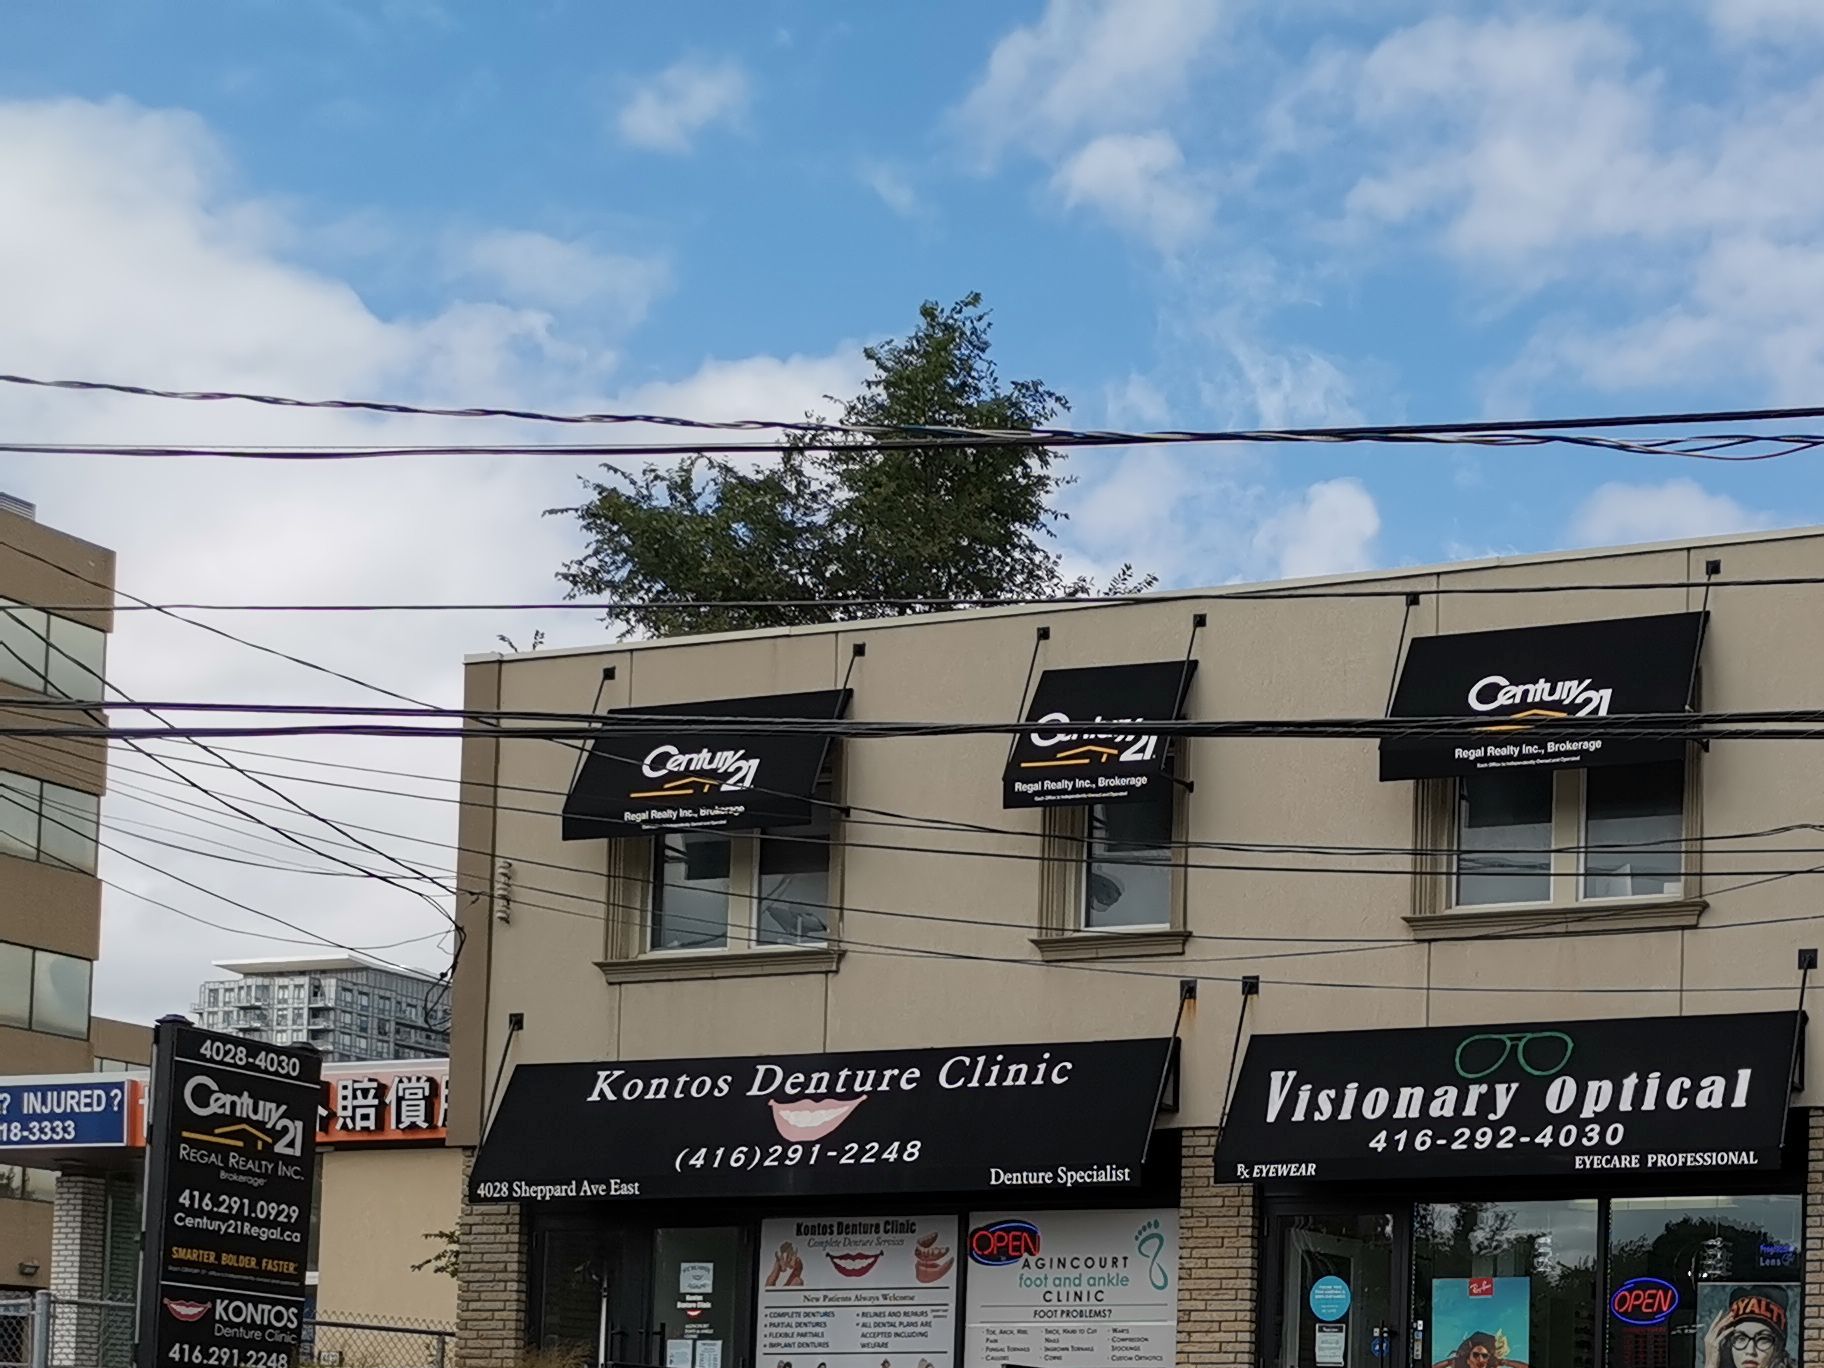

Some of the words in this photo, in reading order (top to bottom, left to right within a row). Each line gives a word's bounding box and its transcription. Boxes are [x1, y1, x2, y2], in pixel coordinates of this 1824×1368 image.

[1467, 675, 1592, 712] Century
[1574, 688, 1612, 718] 21
[1455, 746, 1484, 760] Regal
[1487, 744, 1519, 757] Realty
[1522, 743, 1545, 754] Inc.,
[1547, 740, 1602, 752] Brokerage
[642, 745, 745, 778] Century
[720, 759, 760, 791] 21
[1015, 780, 1042, 793] Regal
[1043, 779, 1073, 791] Realty
[1076, 778, 1096, 789] Inc.,
[1098, 776, 1148, 787] Brokerage
[624, 810, 649, 822] Regal
[650, 808, 678, 820] Realty
[679, 807, 698, 817] Inc.,
[200, 1039, 300, 1077] 4028-4030
[587, 1069, 732, 1102] Kontos
[747, 1062, 921, 1097] Denture
[938, 1052, 1073, 1089] Clinic
[316, 1075, 448, 1134] 賠償
[1265, 1069, 1519, 1123] Visionary
[1545, 1067, 1753, 1120] Optical
[184, 1075, 288, 1129] Century
[273, 1117, 304, 1157] 21
[1368, 1122, 1625, 1153] 416-292-4030
[179, 1144, 224, 1167] REGAL
[228, 1151, 275, 1175] REALTY
[278, 1161, 305, 1180] INC.
[674, 1140, 921, 1172] (416)291-2248
[1575, 1154, 1639, 1170] EYECARE
[1647, 1151, 1758, 1168] PROFESSIONAL
[219, 1169, 265, 1187] Brokerage
[990, 1165, 1053, 1187] Denture
[1057, 1163, 1130, 1187] Specialist
[1252, 1163, 1317, 1178] EYEWEAR
[477, 1181, 509, 1198] 4028
[512, 1180, 576, 1200] Sheppard
[579, 1179, 607, 1196] Ave
[609, 1179, 640, 1196] East
[178, 1189, 299, 1224] 416.291.0929
[173, 1212, 302, 1243] Century21Regal.ca
[796, 1221, 834, 1237] Kontos
[836, 1220, 880, 1236] Denture
[883, 1219, 917, 1235] Clinic
[807, 1237, 841, 1250] Complete
[972, 1230, 1041, 1257] OPEN
[171, 1246, 219, 1265] SMARTER.
[221, 1252, 260, 1270] BOLDER.
[1021, 1256, 1129, 1270] AGINCOURT
[1019, 1272, 1048, 1288] foot
[1053, 1272, 1082, 1287] and
[1087, 1272, 1130, 1287] ankle
[1043, 1290, 1105, 1302] CLINIC
[1614, 1289, 1672, 1313] OPEN
[215, 1299, 298, 1329] KONTOS
[1033, 1310, 1058, 1318] FOOT
[1060, 1309, 1112, 1318] PROBLEMS?
[214, 1324, 262, 1341] Denture
[265, 1328, 298, 1344] Clinic
